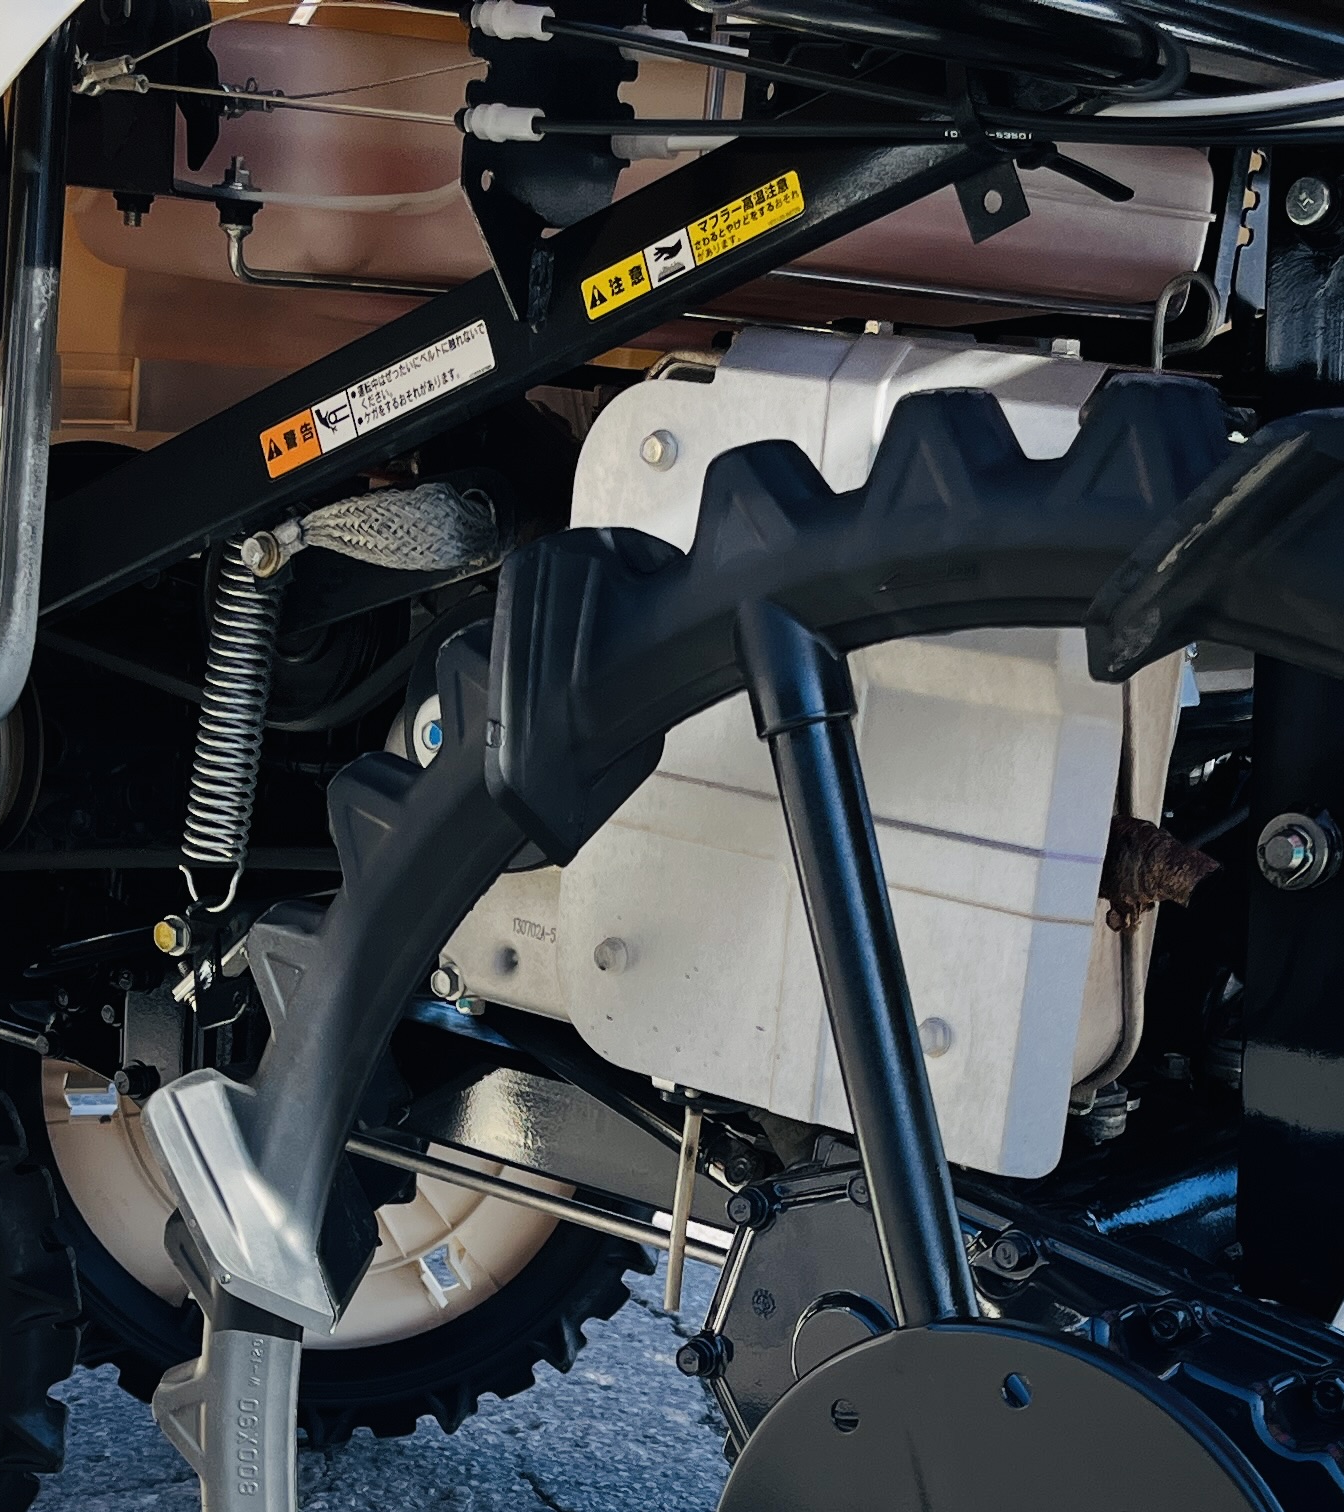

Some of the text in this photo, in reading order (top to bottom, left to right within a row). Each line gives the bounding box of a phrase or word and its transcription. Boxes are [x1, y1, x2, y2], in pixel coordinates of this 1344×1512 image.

[694, 190, 801, 251] さわるとやけどをするおそれ
[697, 177, 789, 234] マフラー高温注意
[697, 235, 742, 262] があります。
[609, 264, 645, 297] 注意
[357, 323, 485, 398] 運転中はぜったいにベルトに触れないで
[361, 389, 393, 409] ください。
[364, 368, 460, 424] ケガをするおそれがあります。
[283, 421, 314, 451] 警告
